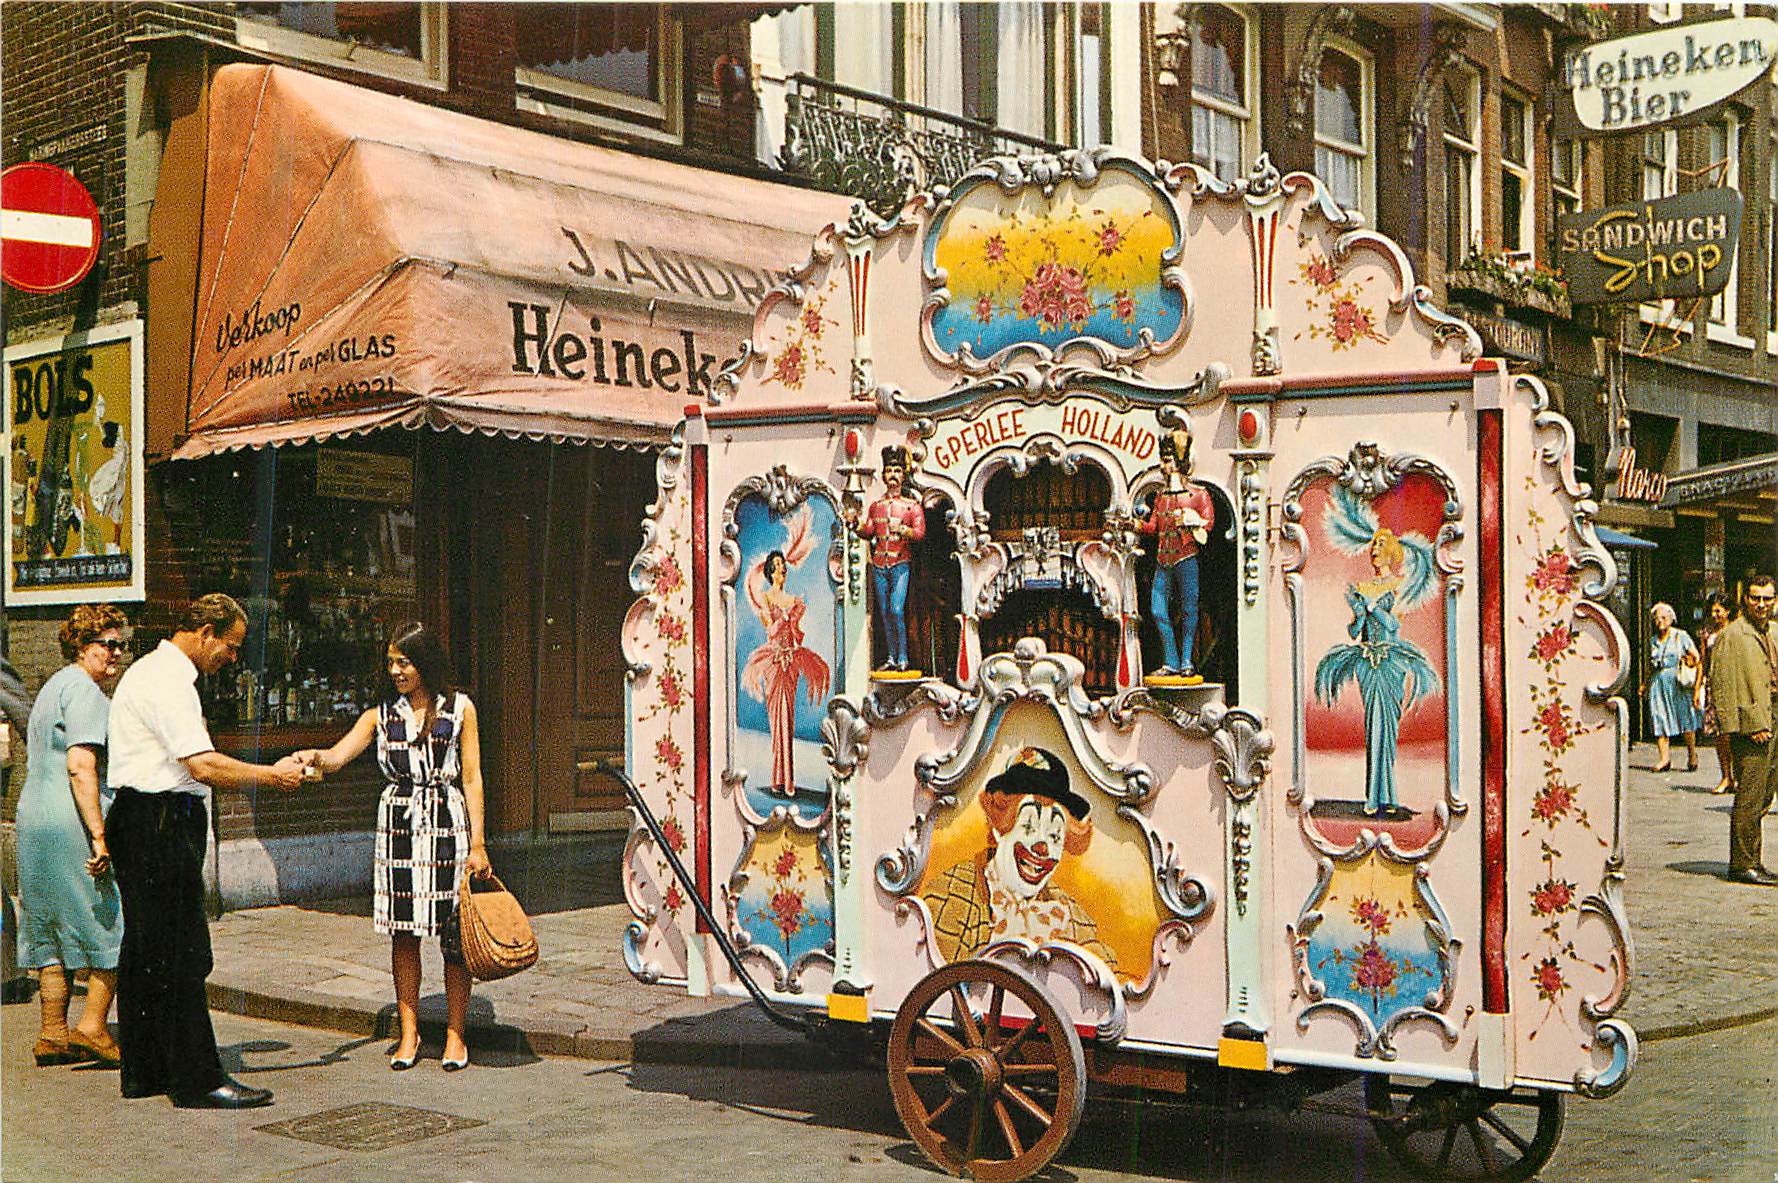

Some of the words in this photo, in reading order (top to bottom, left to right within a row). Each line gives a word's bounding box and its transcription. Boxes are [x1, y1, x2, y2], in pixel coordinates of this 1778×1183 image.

[1566, 35, 1768, 89] Heineken
[1601, 86, 1692, 128] Bier
[1562, 213, 1728, 252] SANDWICH
[1593, 205, 1723, 293] Shop
[216, 300, 301, 352] Verkoop
[249, 349, 300, 380] MAAT
[299, 356, 314, 371] en
[338, 334, 396, 363] GLAS
[14, 353, 94, 425] BOLS
[1061, 406, 1156, 461] HOLLAND
